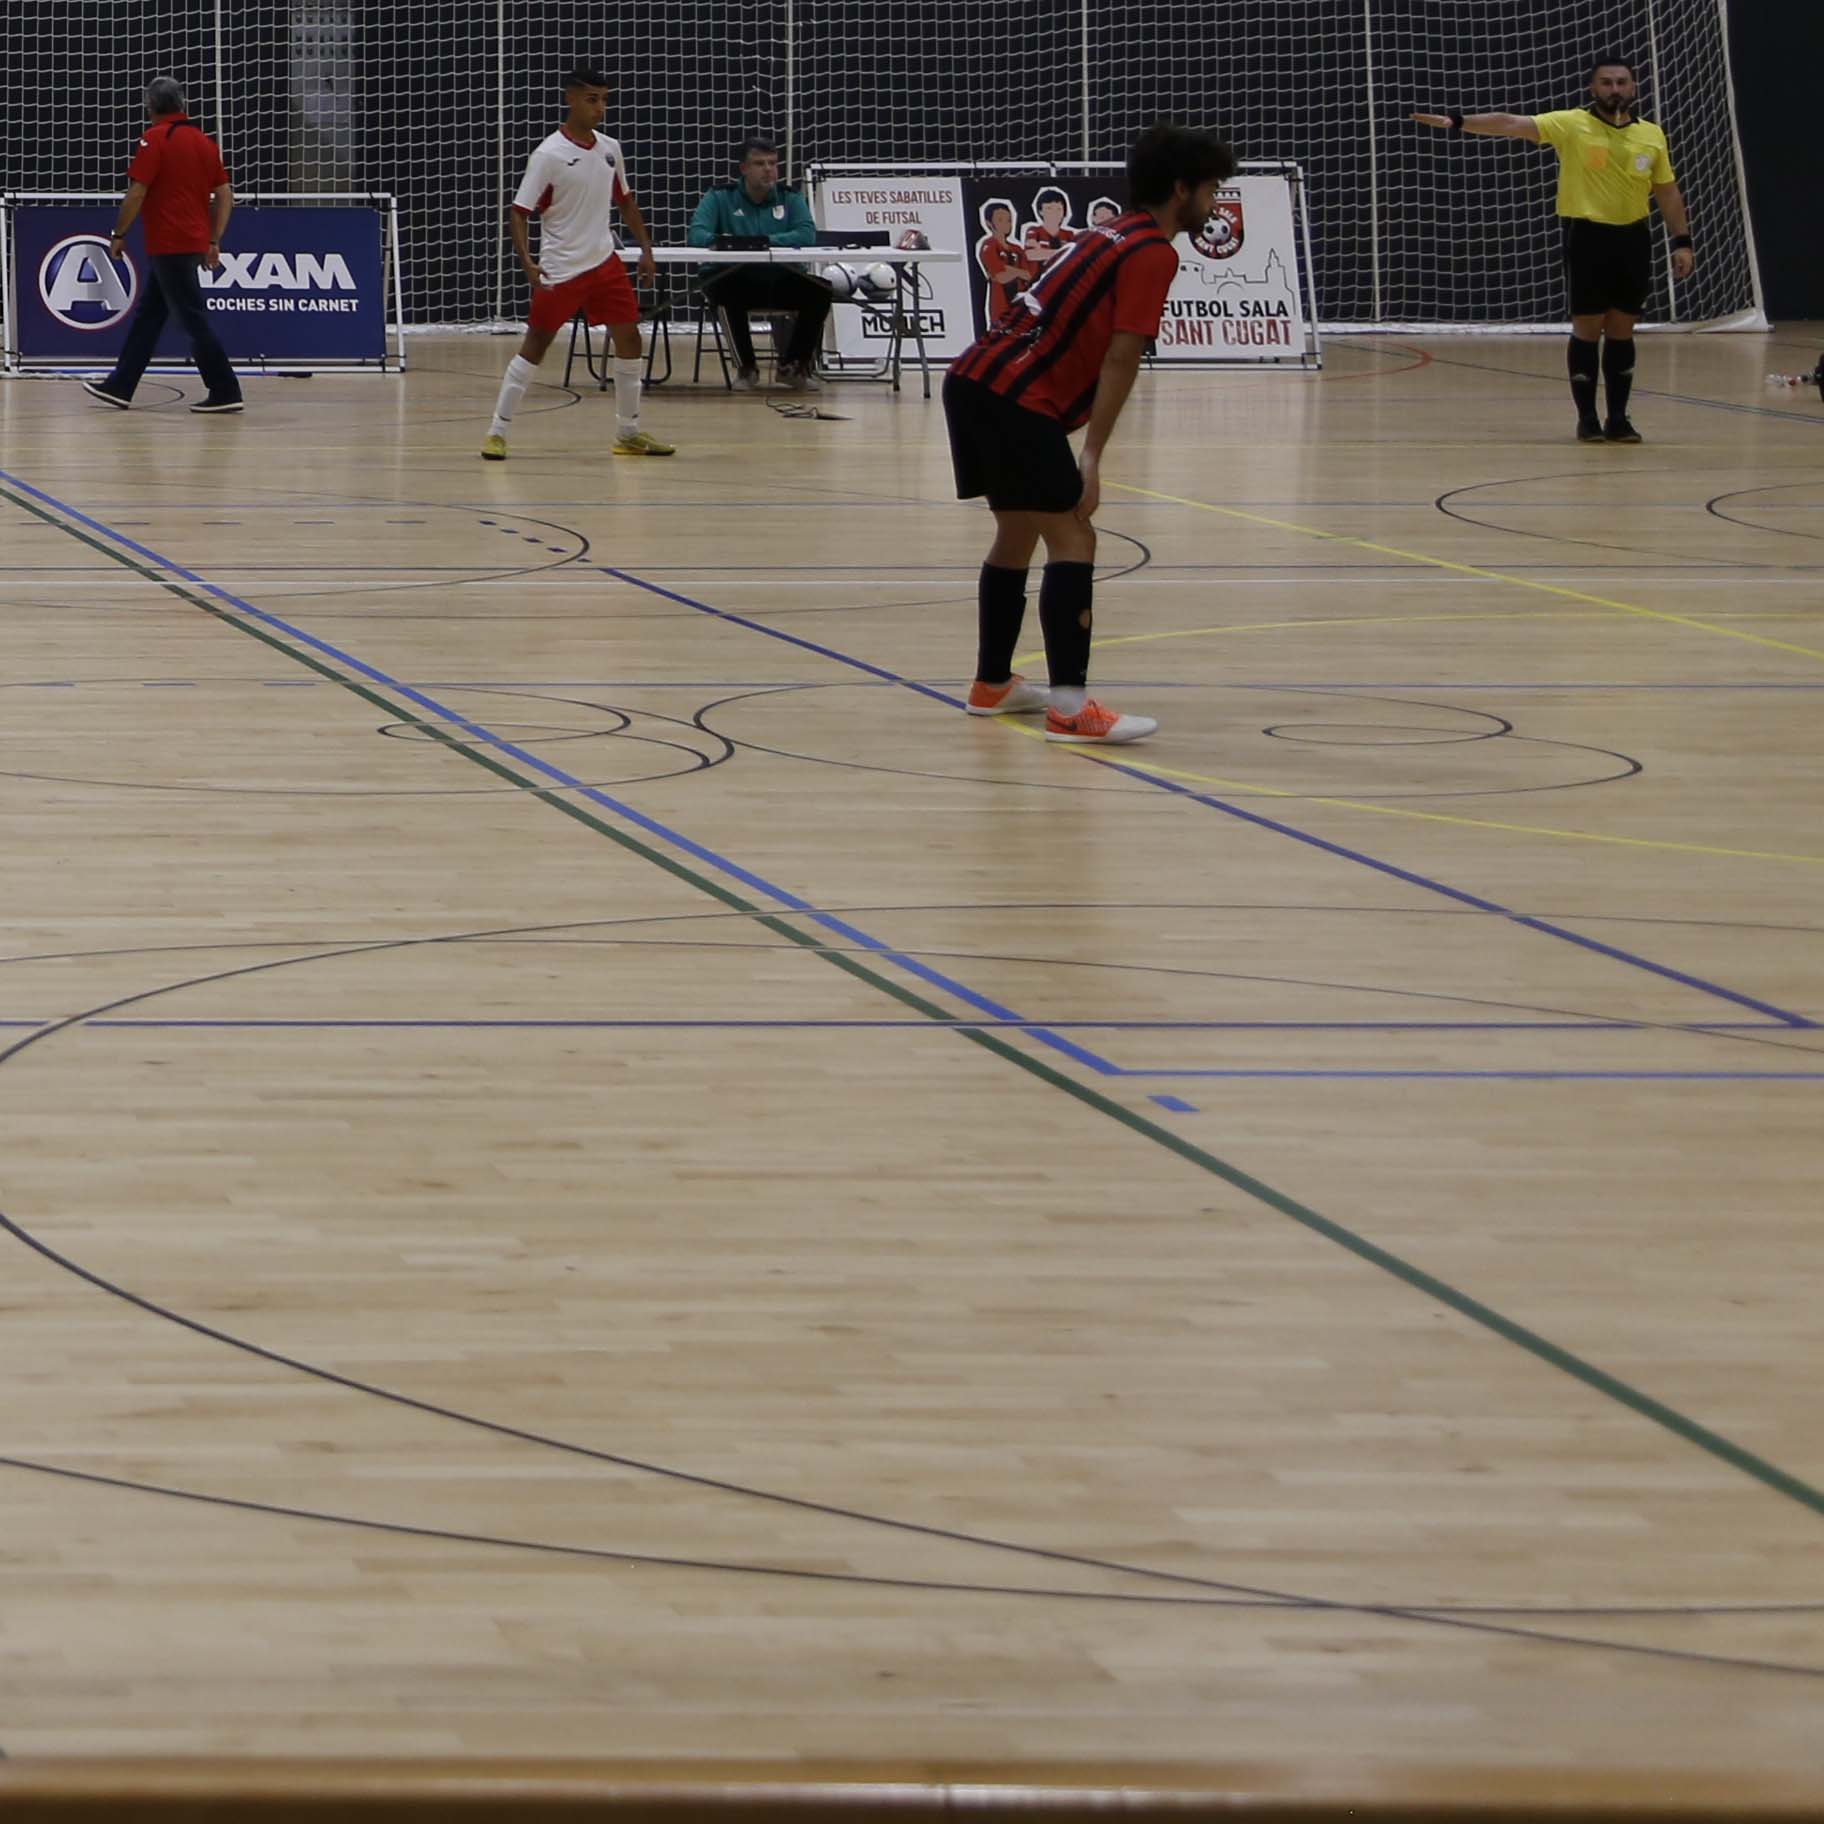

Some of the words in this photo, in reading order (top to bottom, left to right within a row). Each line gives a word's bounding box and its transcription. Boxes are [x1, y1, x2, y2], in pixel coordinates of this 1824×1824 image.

[832, 191, 851, 204] LES
[854, 191, 887, 204] TEVES
[889, 191, 952, 204] SABATILLES
[866, 211, 879, 224] DE
[882, 211, 922, 224] FUTSAL
[206, 297, 265, 311] COCHES
[269, 298, 294, 311] SIN
[298, 299, 359, 312] CARNET
[1239, 300, 1289, 318] SALA
[1161, 319, 1214, 346] SANT
[1223, 319, 1291, 346] CUGAT
